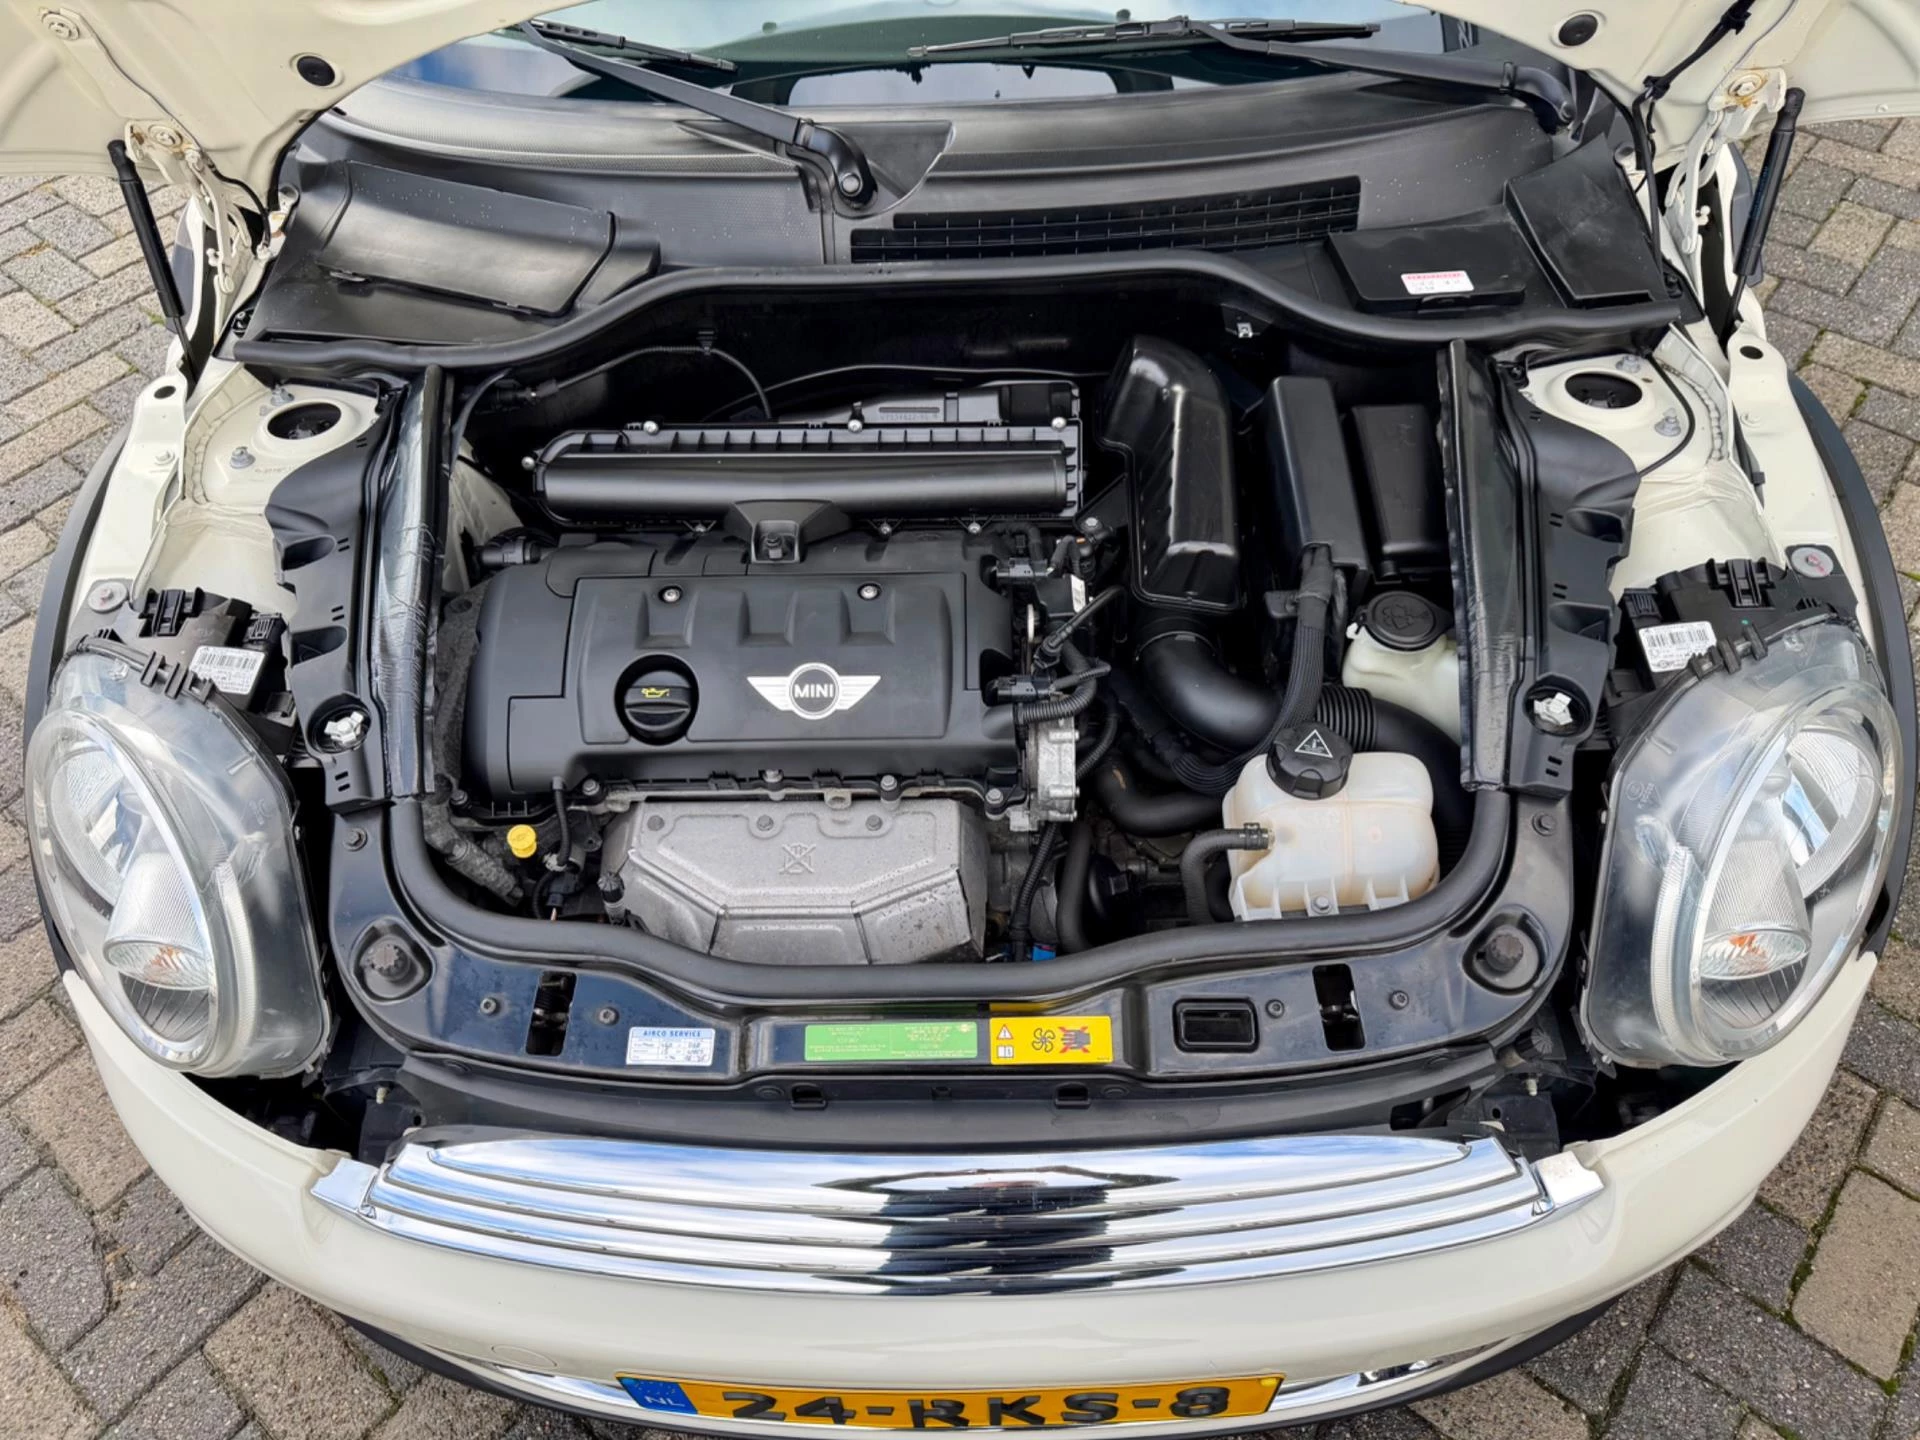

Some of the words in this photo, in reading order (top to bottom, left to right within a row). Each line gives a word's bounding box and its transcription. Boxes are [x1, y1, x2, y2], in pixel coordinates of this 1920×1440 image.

[794, 683, 834, 699] MINI
[643, 1029, 667, 1038] AIRCO
[669, 1029, 702, 1038] SERVICE
[644, 1395, 686, 1408] NL
[722, 1386, 1230, 1429] 24-RKS-8
